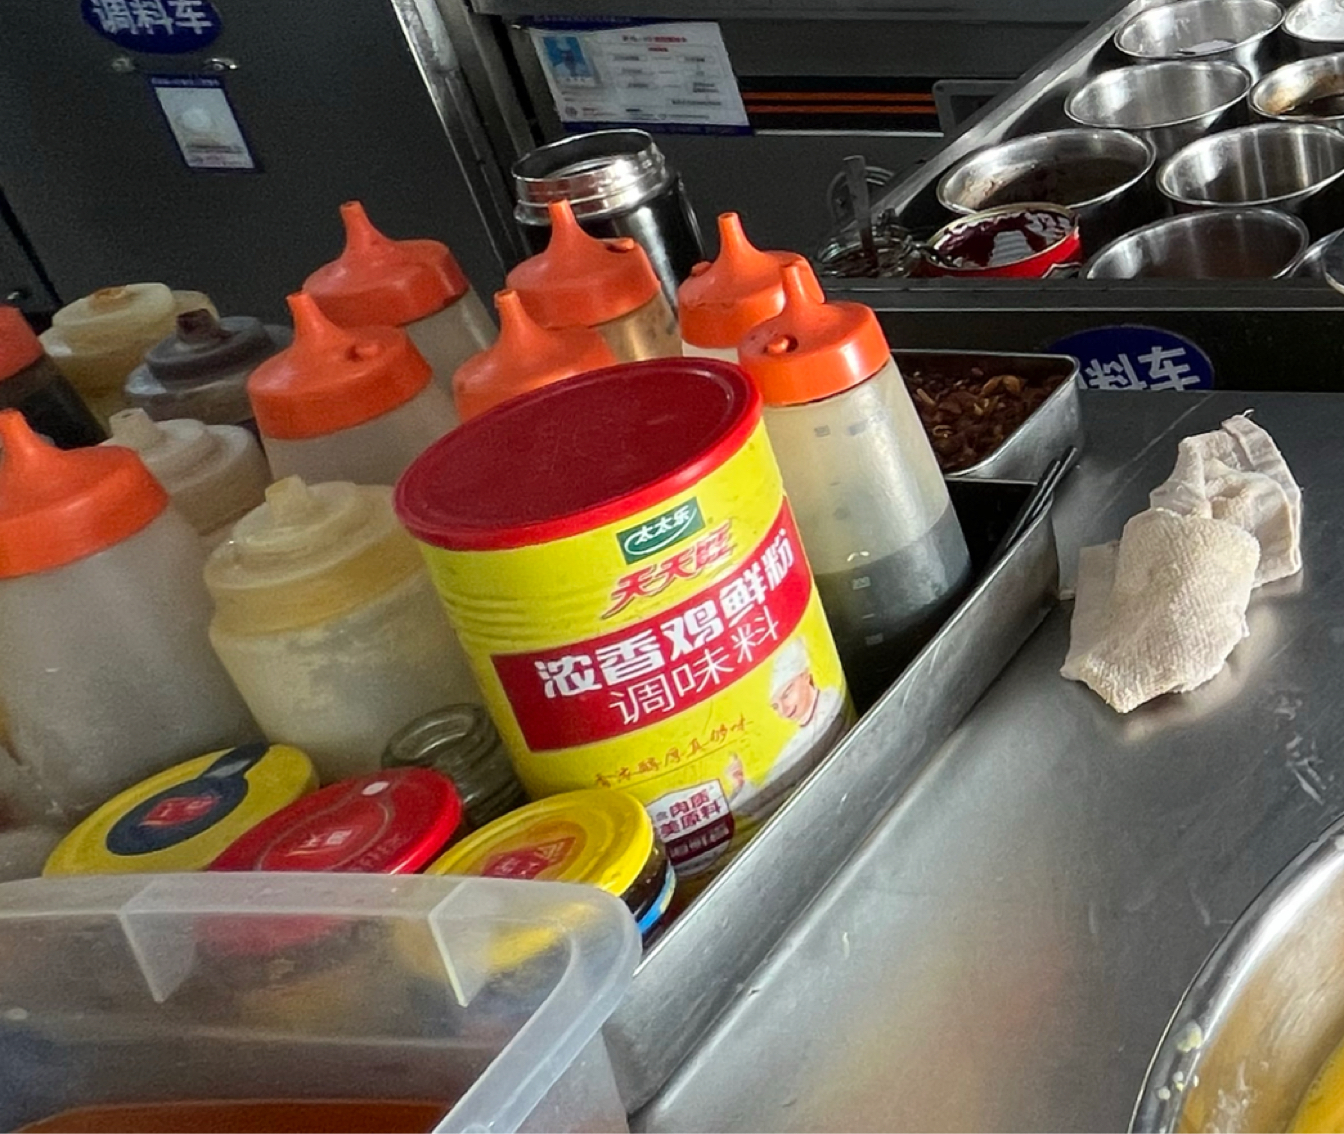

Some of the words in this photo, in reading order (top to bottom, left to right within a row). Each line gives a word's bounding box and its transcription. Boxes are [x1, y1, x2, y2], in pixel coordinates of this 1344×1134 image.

[1078, 346, 1201, 390] 料车
[634, 504, 690, 545] 太太乐
[534, 528, 795, 698] 浓香鸡鲜粉
[609, 605, 779, 726] 调味料
